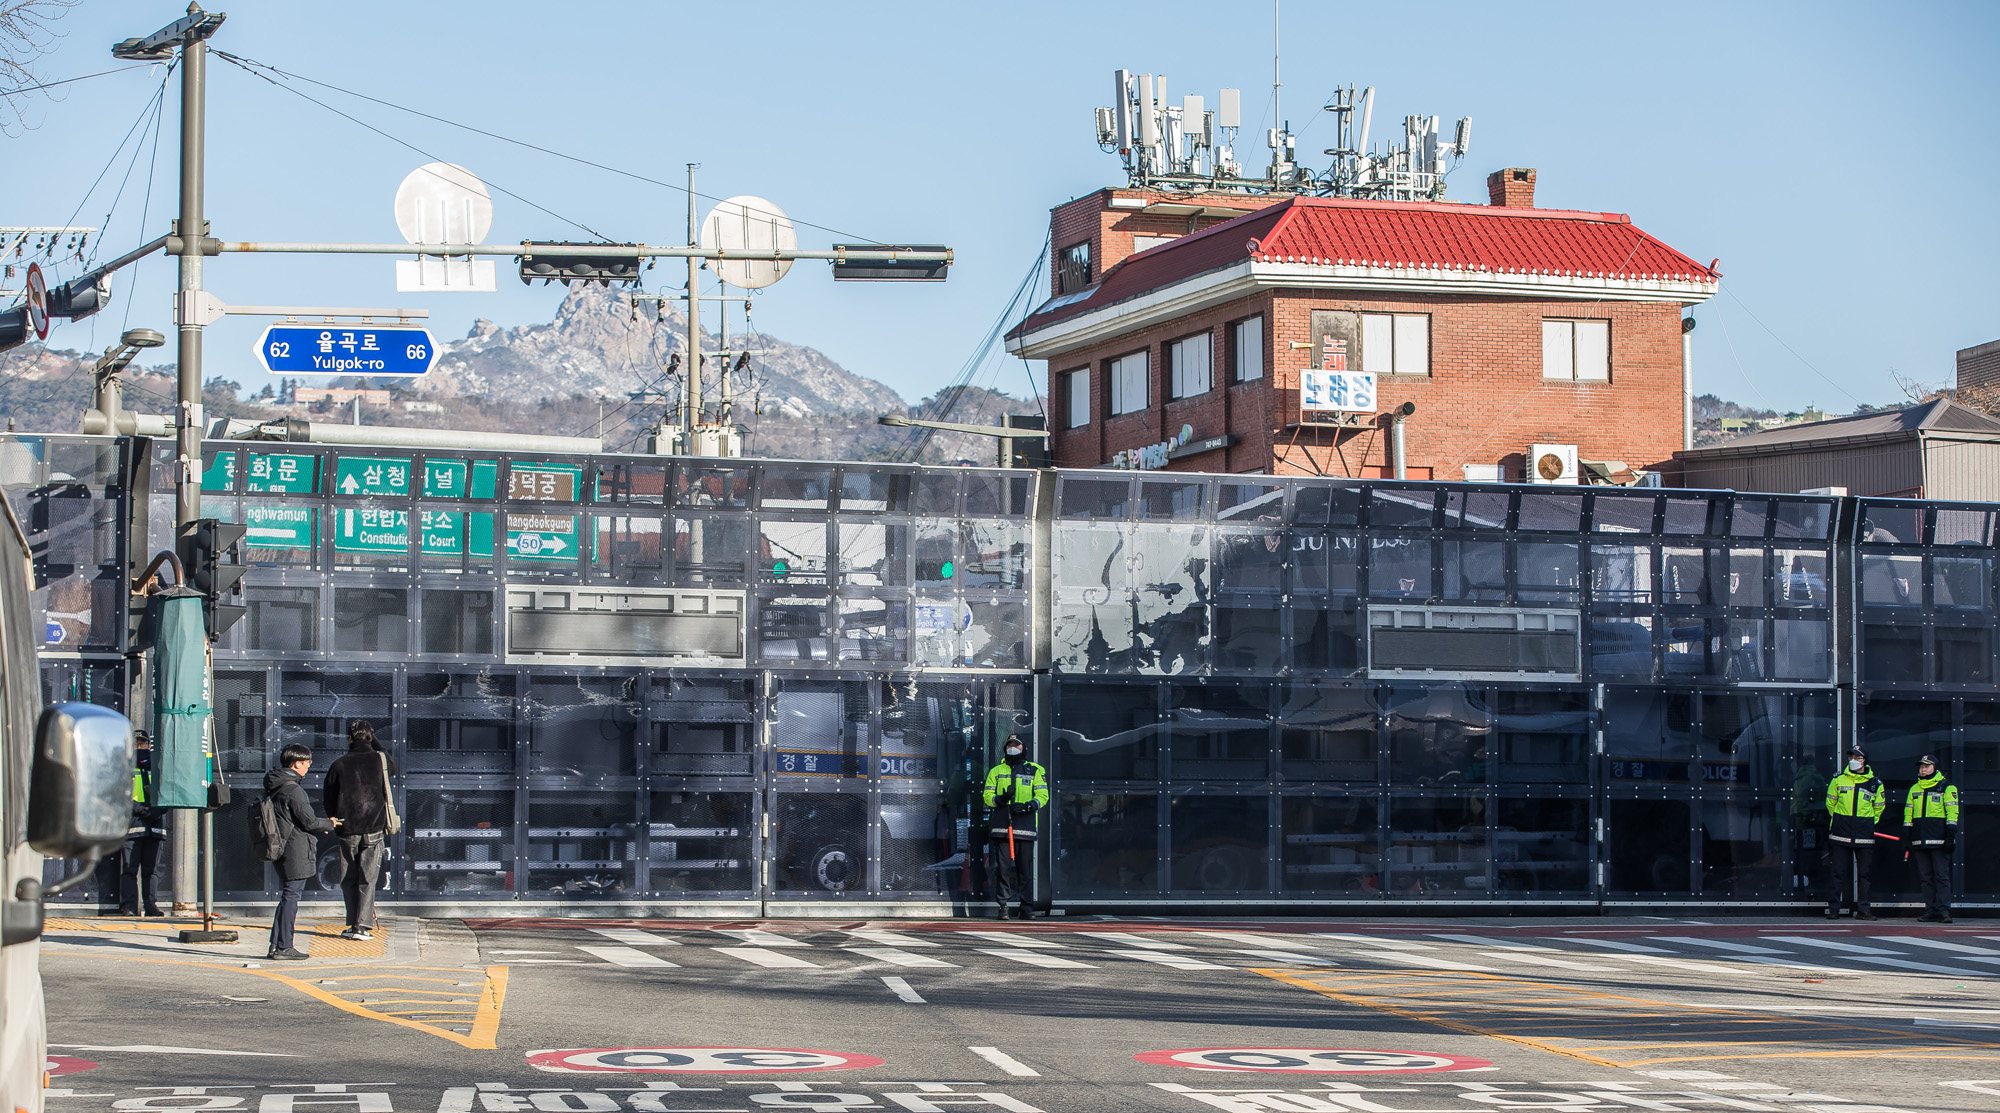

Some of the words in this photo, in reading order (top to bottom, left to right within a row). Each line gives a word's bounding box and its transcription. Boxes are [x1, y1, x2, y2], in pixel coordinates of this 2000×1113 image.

[270, 342, 290, 358] 62
[316, 331, 381, 353] 율곡로
[406, 344, 426, 360] 66
[312, 355, 385, 371] Yulgok-ro
[362, 464, 453, 489] 삼청널
[247, 505, 308, 522] nghwamun
[507, 513, 572, 532] hangdeokgung
[359, 530, 425, 546] Constitutiol
[429, 533, 455, 547] Court
[521, 539, 538, 549] 50
[782, 754, 819, 772] 경찰
[880, 758, 925, 775] OLICE
[1612, 761, 1645, 778] 경찰
[1688, 765, 1738, 781] OLICE
[598, 1051, 825, 1067] 30
[1201, 1052, 1438, 1068] 30
